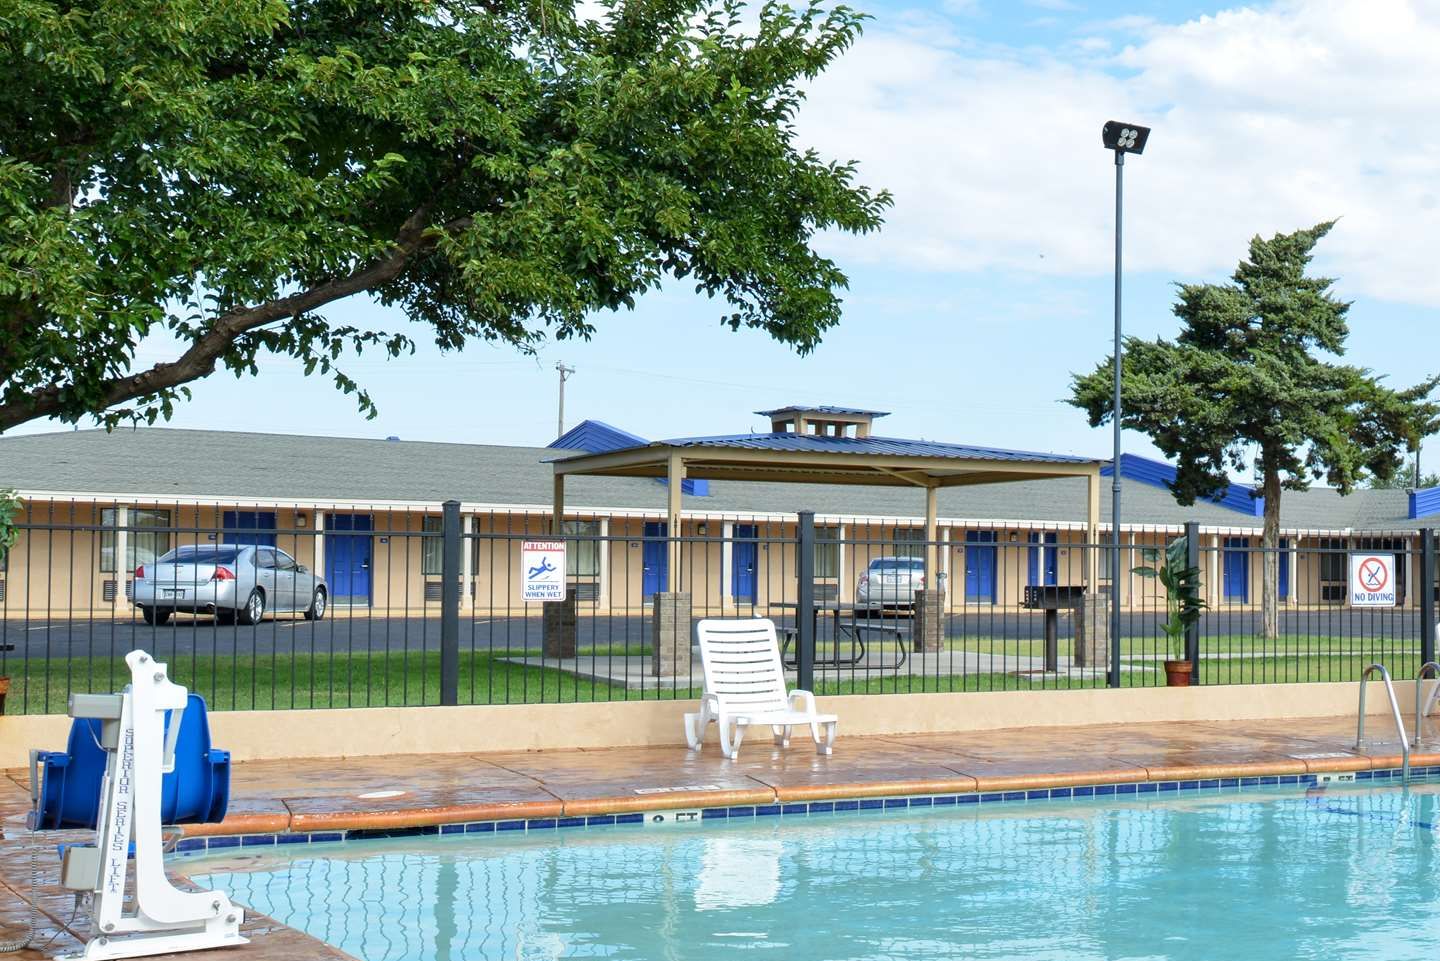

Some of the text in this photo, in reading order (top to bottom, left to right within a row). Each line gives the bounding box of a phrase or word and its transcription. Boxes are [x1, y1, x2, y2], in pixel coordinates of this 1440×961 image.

[523, 541, 564, 550] ATTENTION
[1354, 592, 1394, 601] NO DIVING
[108, 728, 134, 893] SUPERIOR SERIES LIFT
